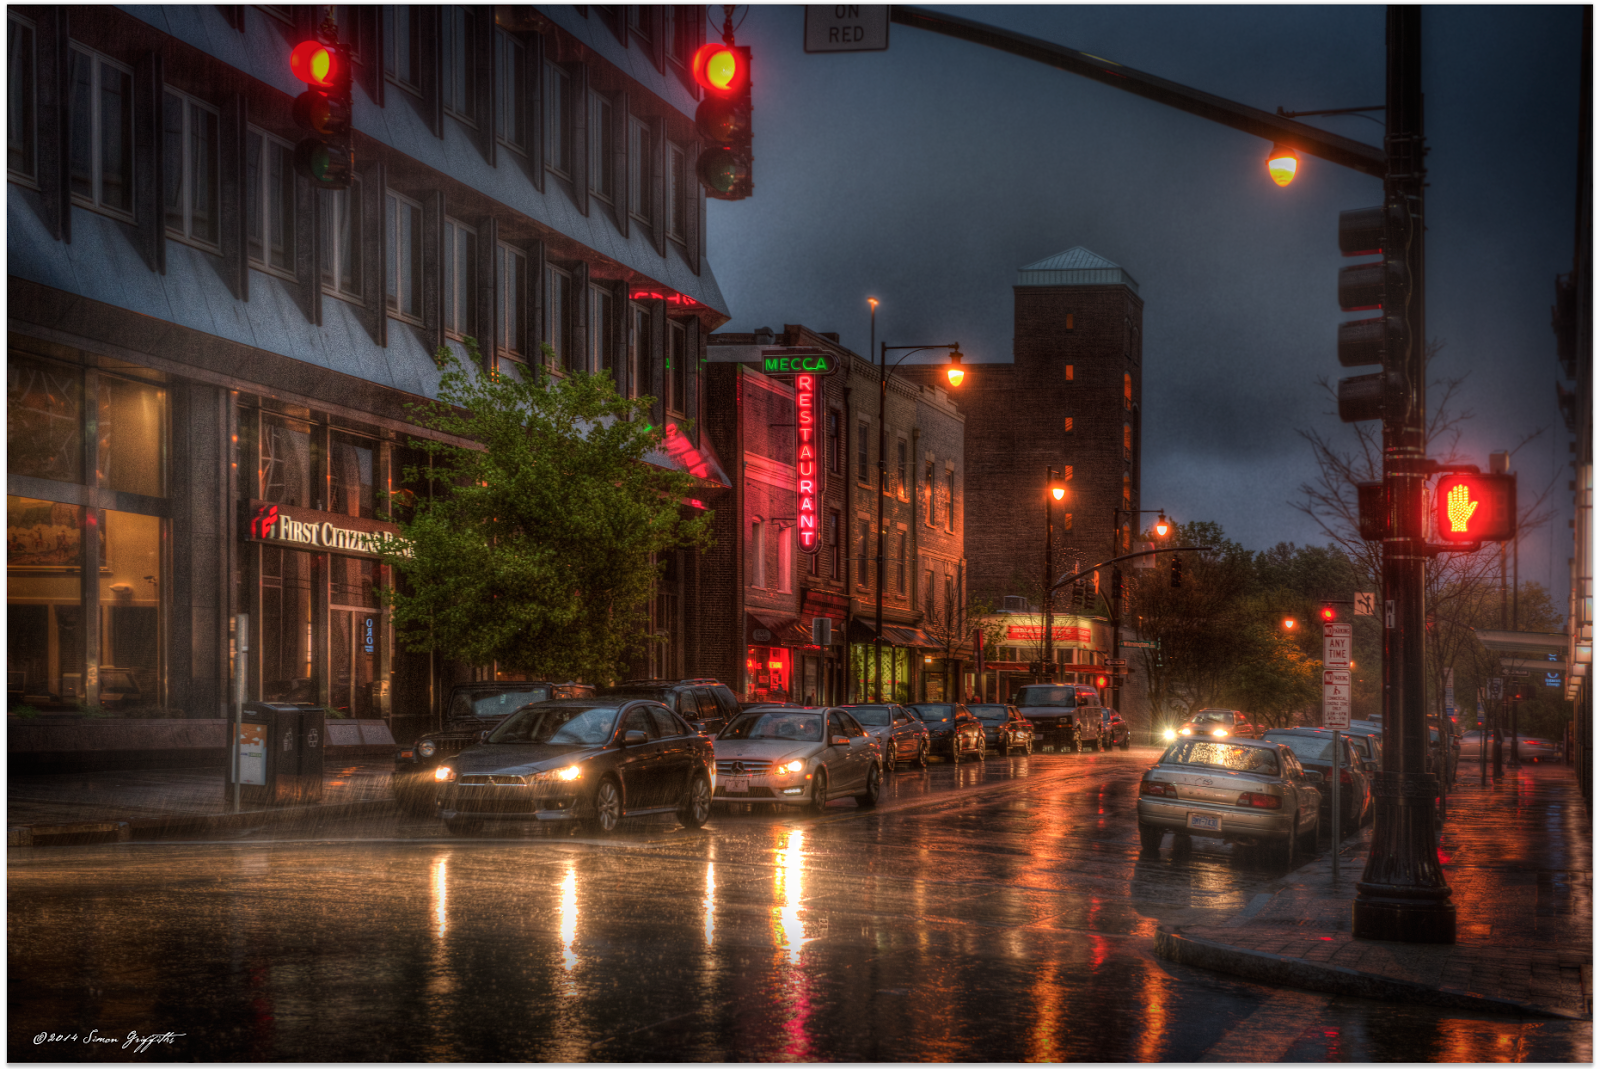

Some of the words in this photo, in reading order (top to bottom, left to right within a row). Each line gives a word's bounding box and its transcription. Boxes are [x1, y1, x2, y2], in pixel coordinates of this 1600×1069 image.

[835, 5, 859, 19] ON
[829, 25, 864, 43] RED
[765, 357, 828, 372] MECCA
[799, 376, 814, 546] RESTAURANT
[279, 515, 320, 546] FIRST
[1329, 639, 1345, 648] ANY
[1329, 650, 1347, 658] TIME
